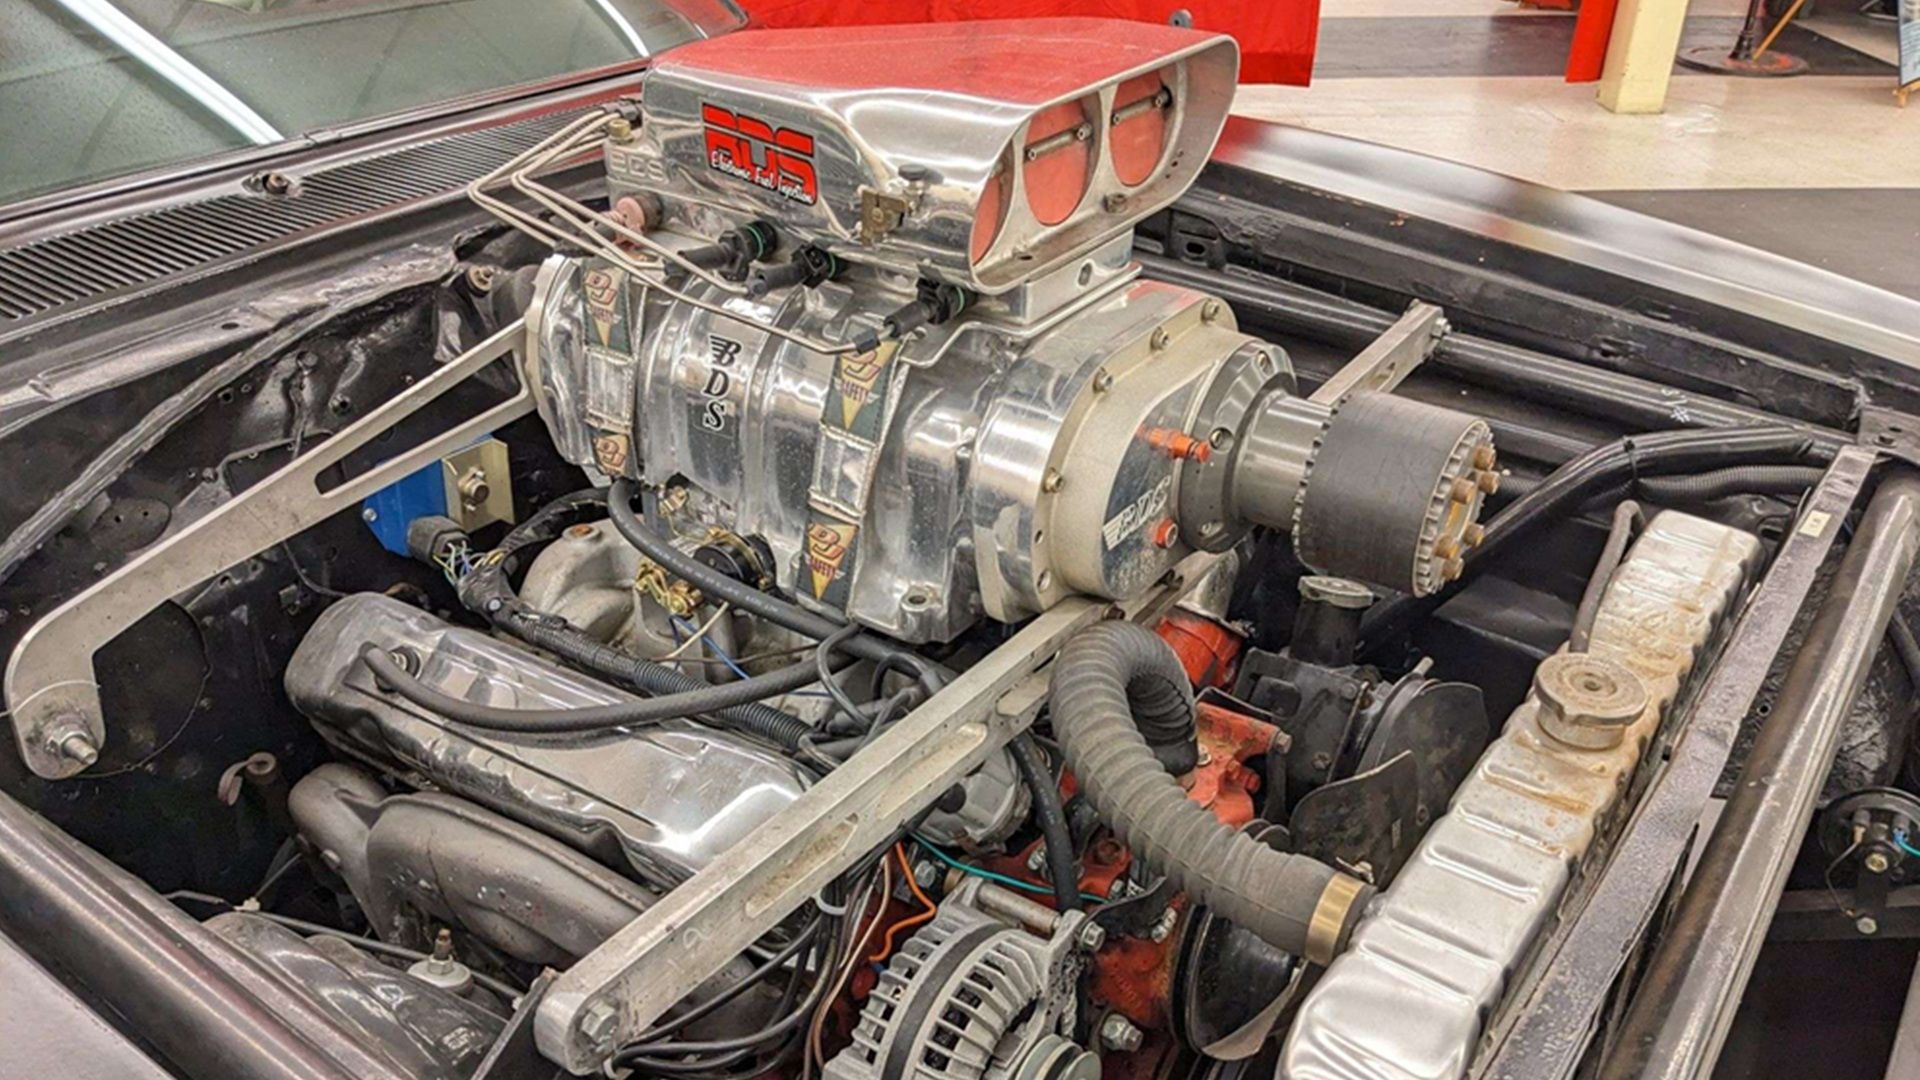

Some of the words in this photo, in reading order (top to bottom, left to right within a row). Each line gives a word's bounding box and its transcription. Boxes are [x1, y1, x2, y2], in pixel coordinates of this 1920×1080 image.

[754, 166, 778, 190] Fuel
[702, 332, 744, 431] BDS
[1102, 474, 1172, 551] BDS
